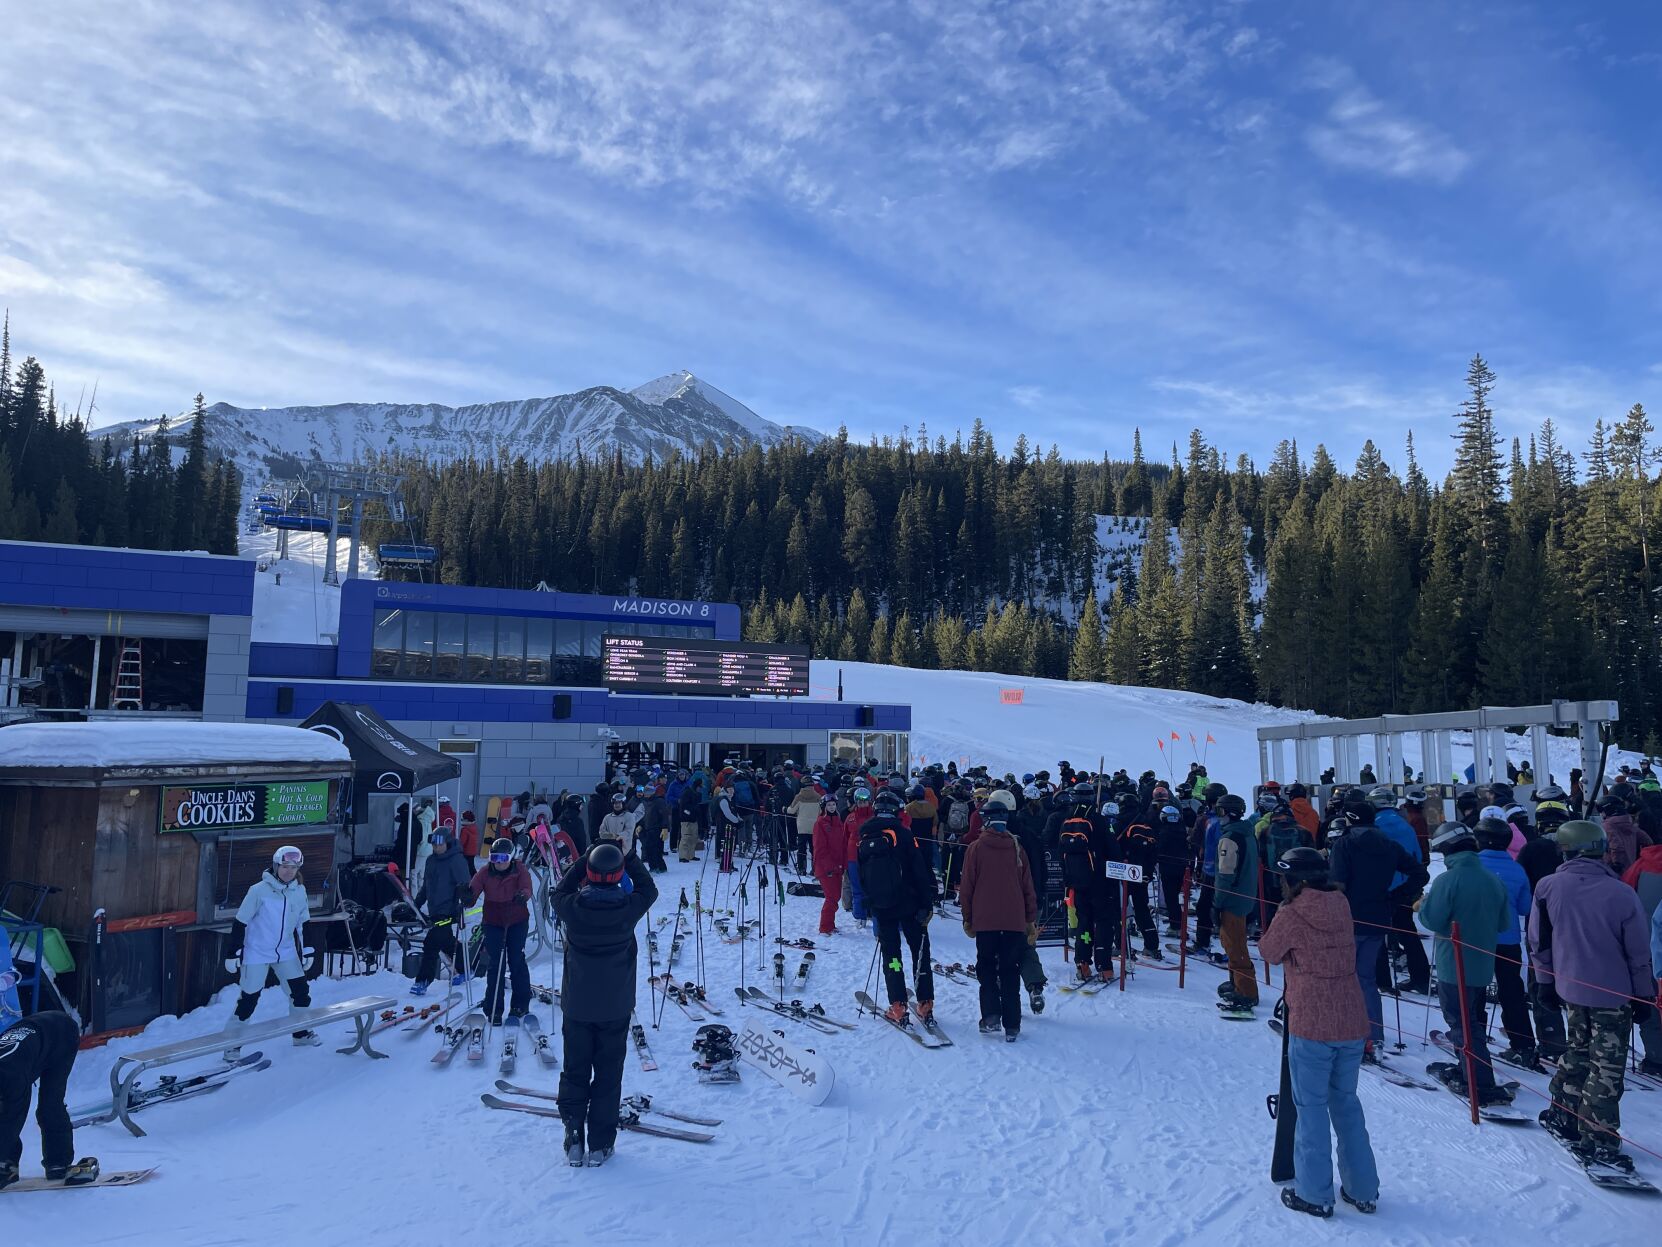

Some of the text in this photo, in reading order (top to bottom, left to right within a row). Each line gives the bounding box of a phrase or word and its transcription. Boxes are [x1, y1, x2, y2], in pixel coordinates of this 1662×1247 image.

[613, 600, 709, 617] MADISON 8
[620, 639, 644, 647] STATUS
[279, 785, 307, 794] PANINIS
[191, 789, 256, 805] UNCLE DAN'S
[279, 794, 324, 804] HOT & COLD
[286, 803, 323, 812] BEVERAGES
[177, 801, 255, 826] COOKIES
[278, 813, 306, 822] COOKIES
